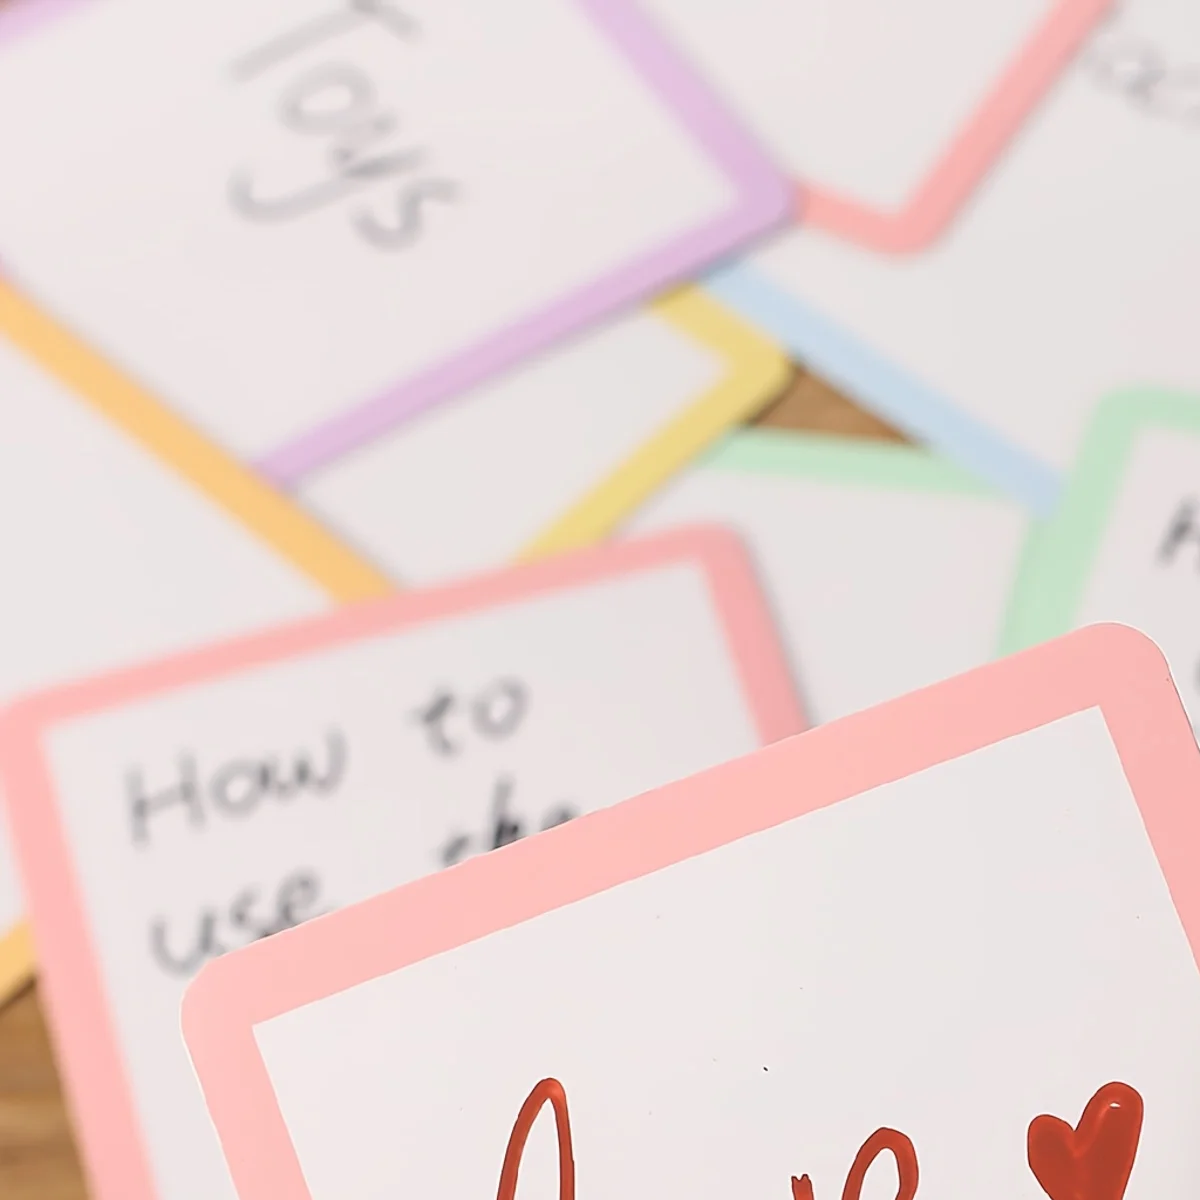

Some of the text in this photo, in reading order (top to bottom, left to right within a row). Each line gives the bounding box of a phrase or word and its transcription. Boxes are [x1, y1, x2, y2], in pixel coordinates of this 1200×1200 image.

[227, 0, 459, 250] Toys
[126, 680, 528, 848] How to
[150, 870, 328, 976] use
